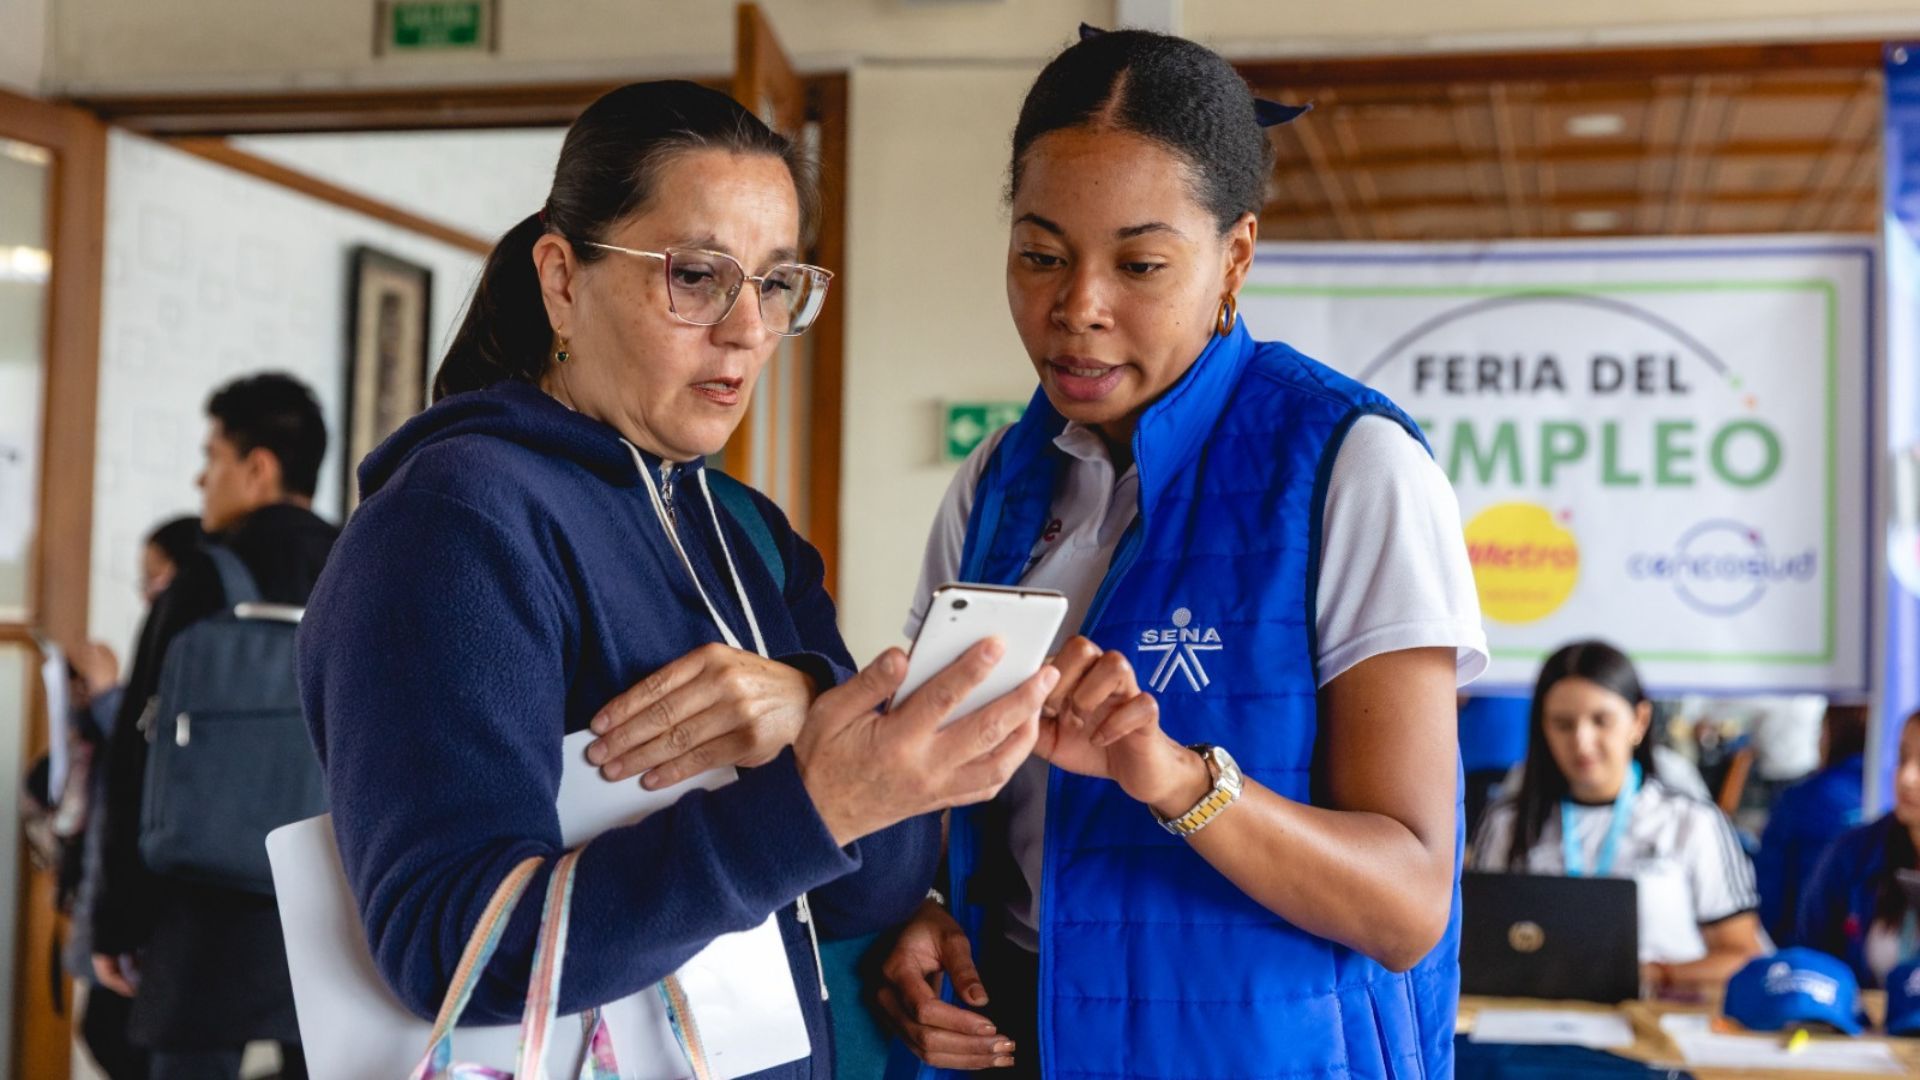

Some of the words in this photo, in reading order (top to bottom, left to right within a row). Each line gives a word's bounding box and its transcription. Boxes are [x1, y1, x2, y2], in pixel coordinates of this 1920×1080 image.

[1413, 354, 1567, 395] FERIA
[1588, 354, 1690, 395] DEL
[1417, 418, 1783, 489] MPLEO
[1625, 548, 1817, 582] cencosud
[1141, 627, 1222, 644] SENA
